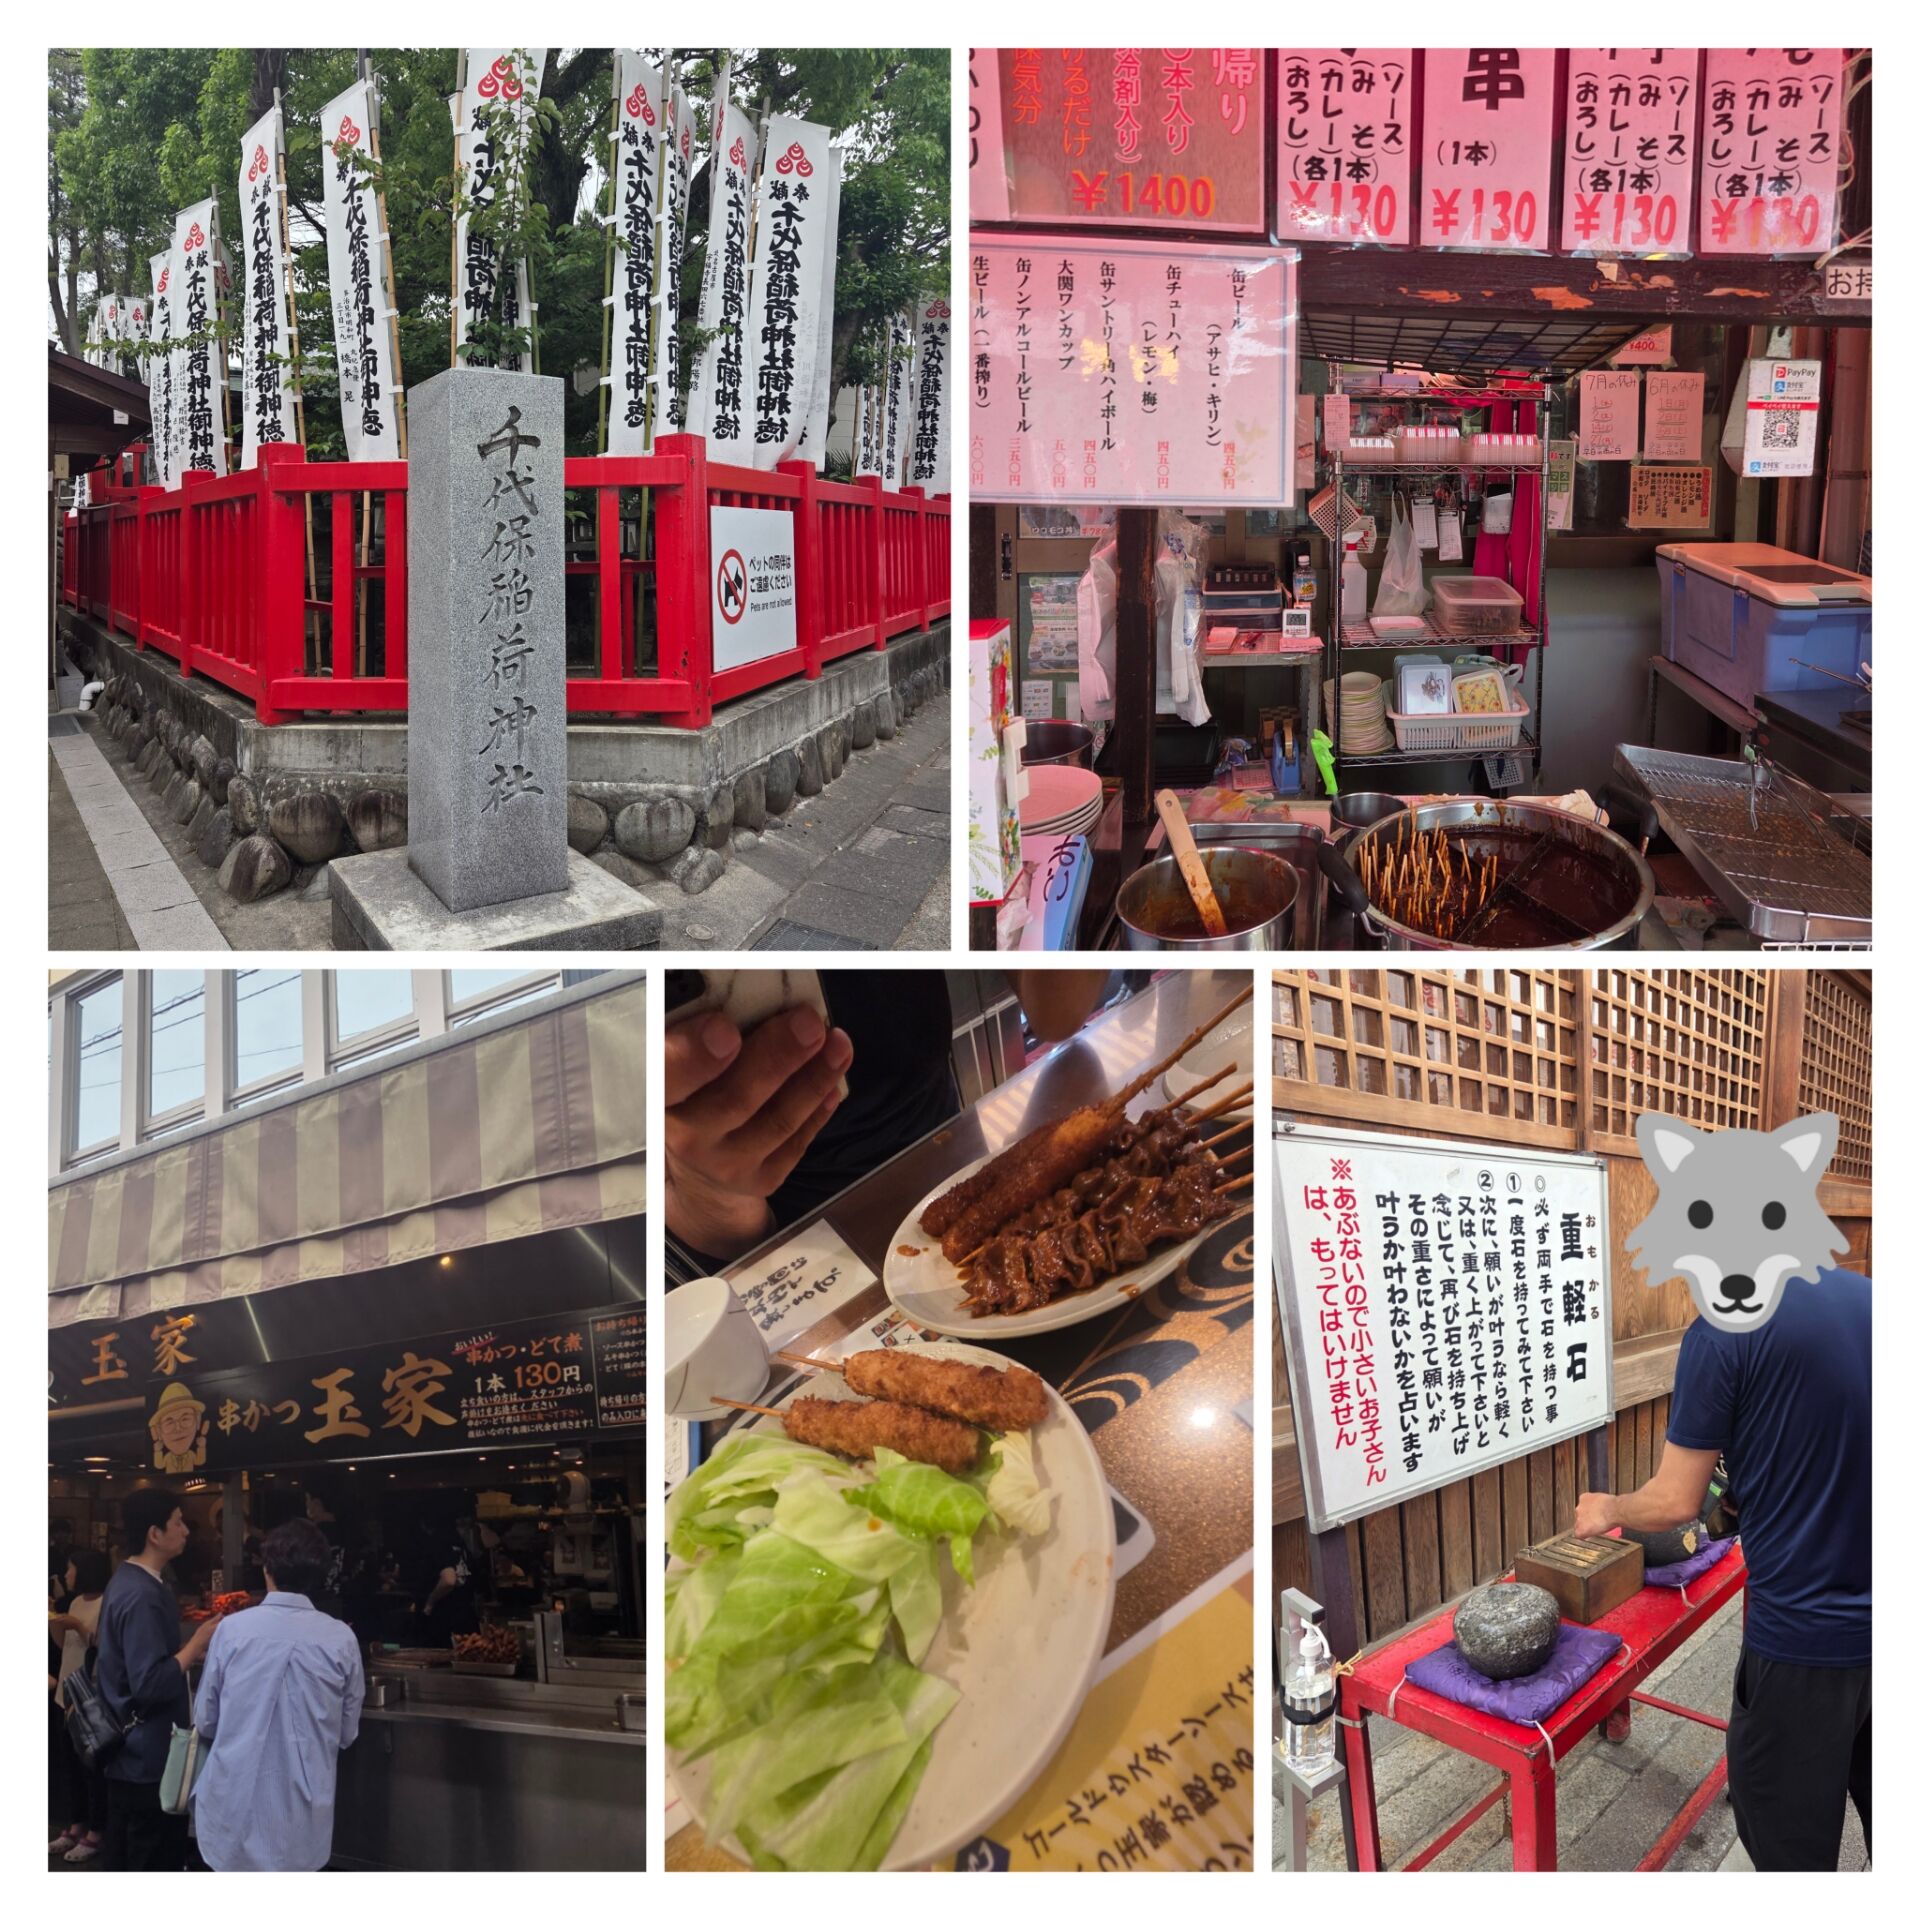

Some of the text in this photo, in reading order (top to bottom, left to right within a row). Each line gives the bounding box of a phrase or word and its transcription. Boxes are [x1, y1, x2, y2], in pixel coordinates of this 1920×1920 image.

[1113, 47, 1142, 163] 冷剤入り）
[1212, 47, 1256, 135] 帰り
[1284, 56, 1309, 148] （おろし）
[1319, 59, 1344, 153] （カレー）
[1381, 63, 1404, 154] （ソース）
[1571, 72, 1598, 161] （おろし）
[1604, 74, 1631, 166] （カレー）
[1664, 76, 1690, 165] （ソース）
[1707, 80, 1735, 168] （おろし）
[1740, 79, 1770, 170] （カレー）
[1806, 75, 1834, 163] （ソース）
[1071, 170, 1215, 217] ¥1400
[1293, 155, 1378, 184] （各1本）
[1437, 140, 1497, 166] （1本）
[1579, 167, 1661, 194] （各1本）
[1714, 170, 1802, 198] （各1本）
[1288, 181, 1396, 236] ¥130
[1432, 188, 1536, 242] ¥130
[1574, 192, 1677, 246] ¥130
[1057, 260, 1074, 370] 大関ワンカップ
[1166, 264, 1182, 359] 缶チューハイ
[1231, 268, 1246, 330] 缶ビール
[1016, 258, 1032, 433] 缶ノンアルコールビール
[1141, 321, 1157, 414] （レモン・梅）
[1206, 322, 1223, 446] （アサヒ・キリン）
[1788, 367, 1816, 378] PayPay
[1009, 438, 1021, 486] 三五〇円
[1084, 440, 1096, 488] 四五〇円
[1157, 440, 1169, 489] 四五〇円
[750, 554, 791, 571] ペットの同伴は
[750, 575, 792, 593] ご遠慮ください
[477, 405, 544, 815] 千代保稲荷神社
[750, 602, 761, 612] Pets
[1303, 1185, 1357, 1449] は、もってはいけません
[1375, 1190, 1423, 1473] 叶うか叶わないかを占います
[1407, 1194, 1445, 1433] その重さによって願いが
[1431, 1193, 1469, 1455] 念じて、再び石を持ち上げ
[1457, 1196, 1490, 1448] 又は、重く上がって下さいと
[1560, 1212, 1588, 1383] 重軽石
[81, 1313, 197, 1386] 玉家
[474, 1361, 581, 1393] 1本 130円
[304, 1351, 458, 1443] 玉家
